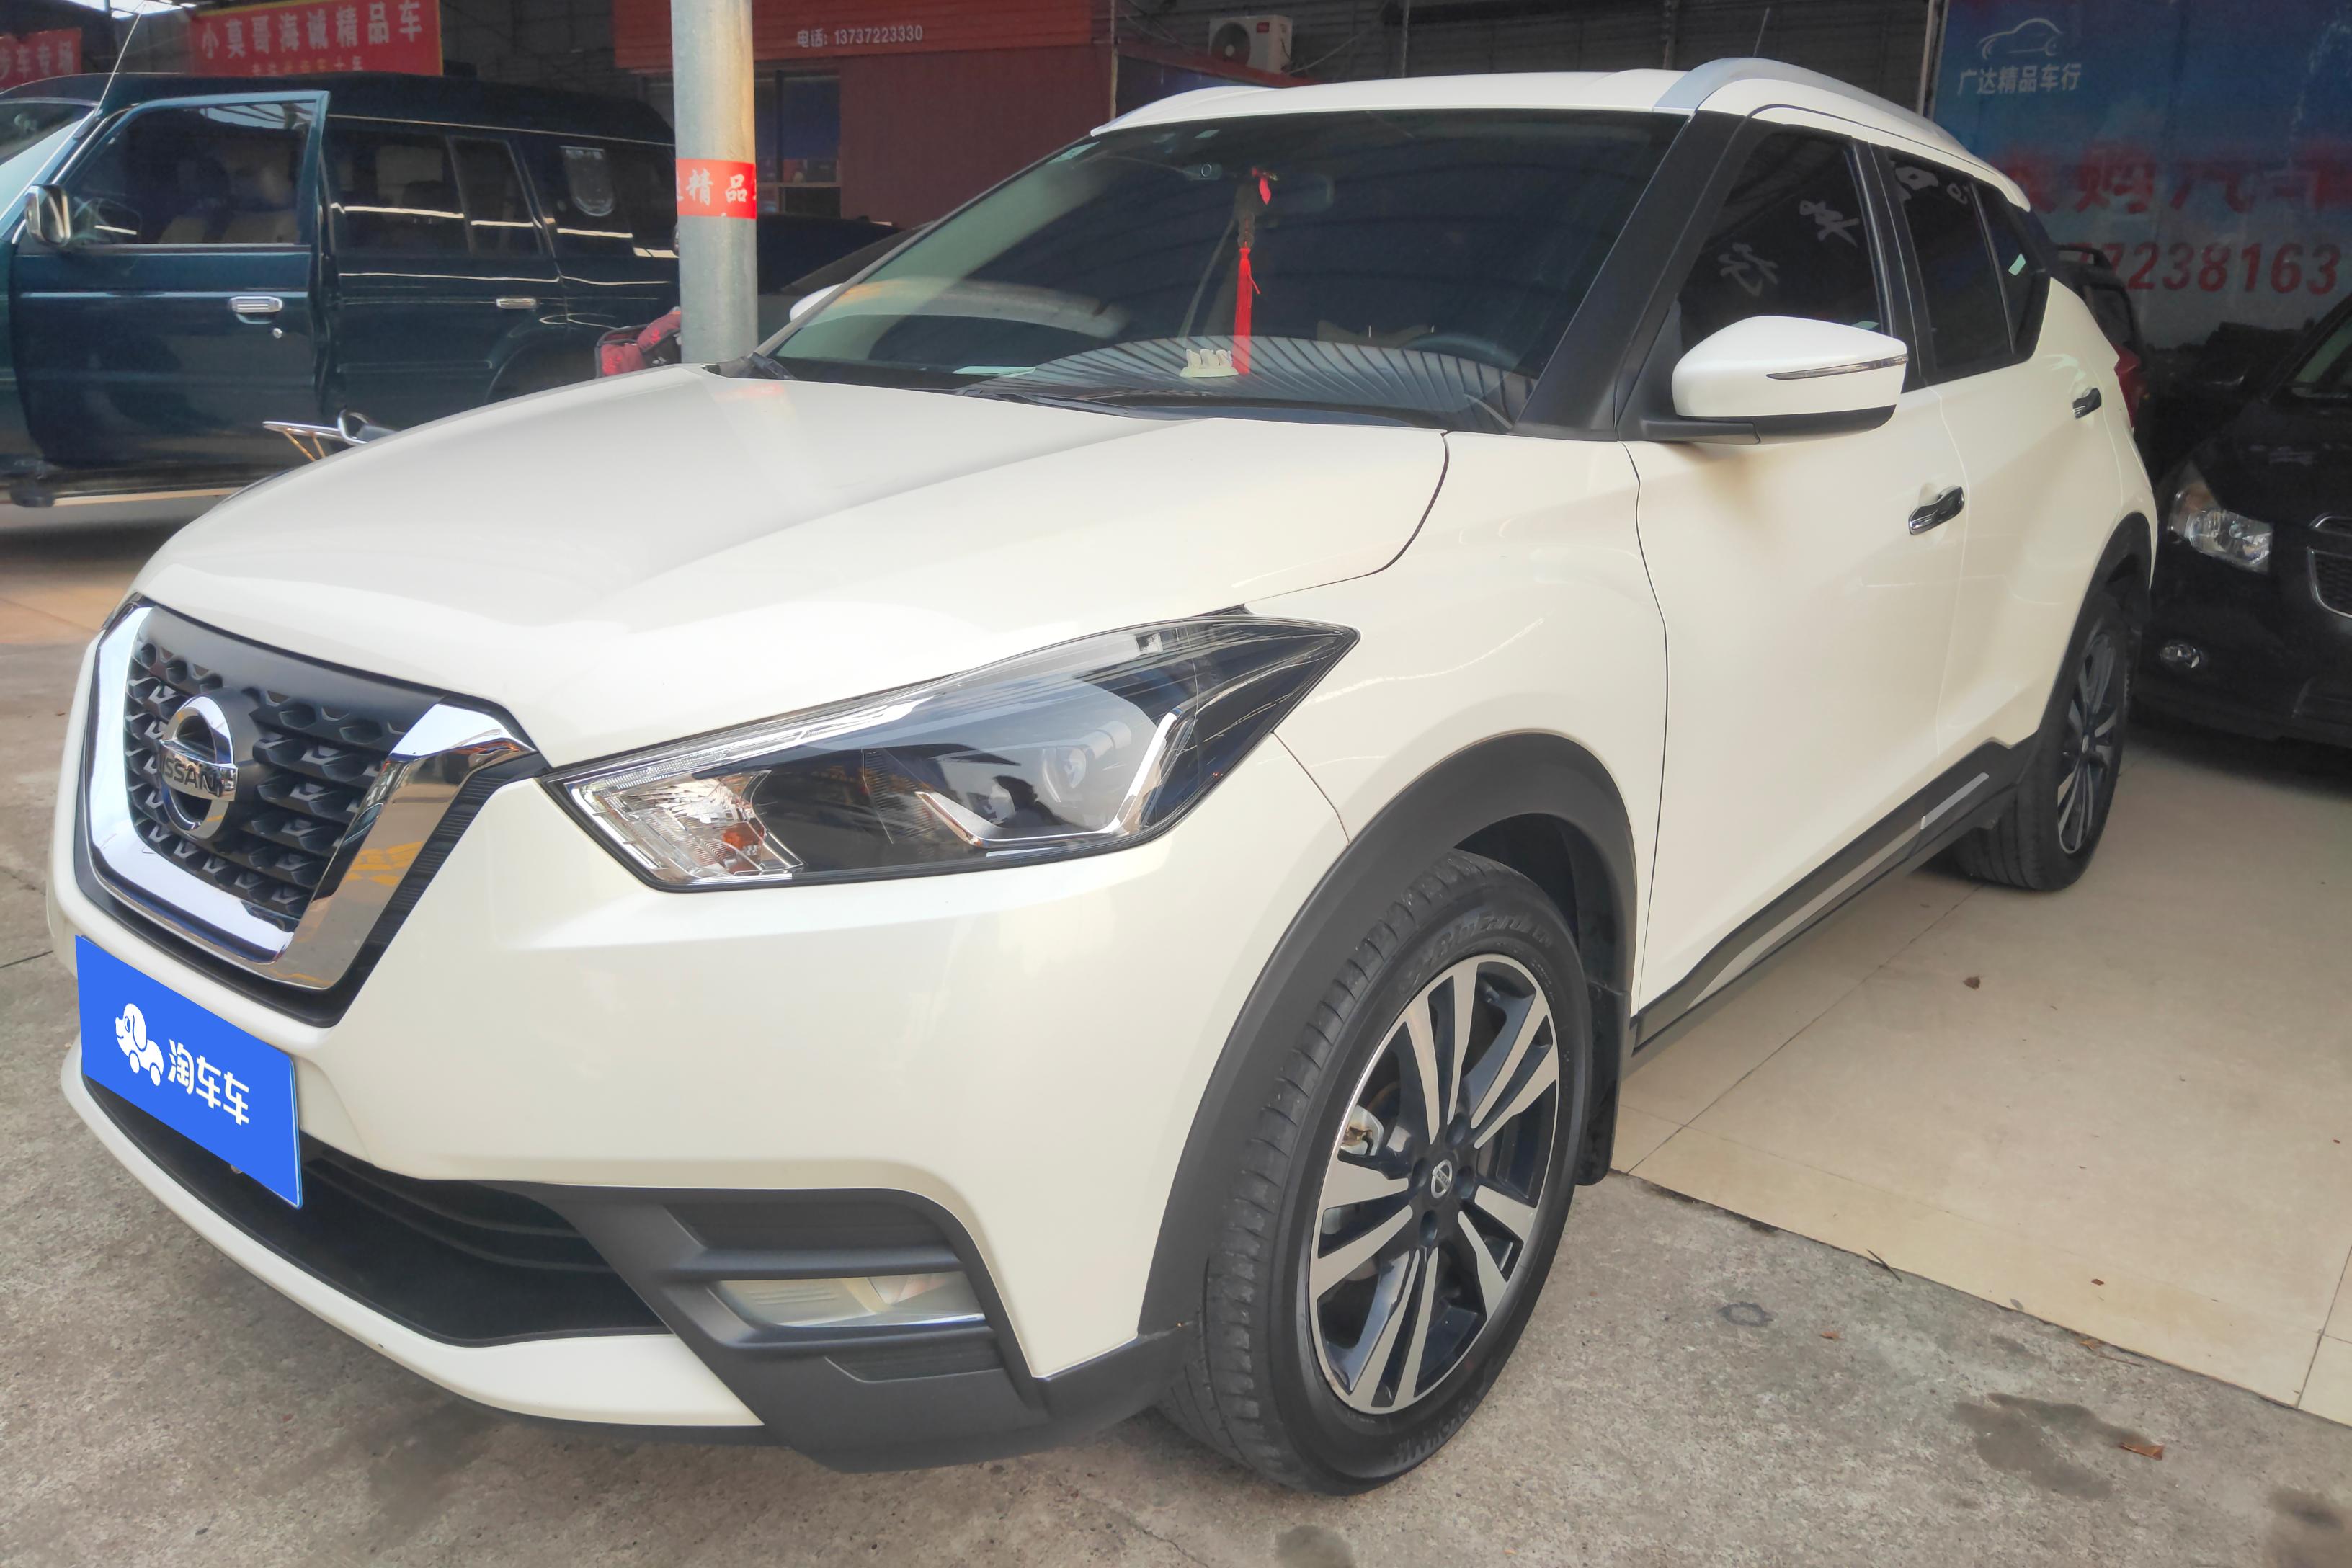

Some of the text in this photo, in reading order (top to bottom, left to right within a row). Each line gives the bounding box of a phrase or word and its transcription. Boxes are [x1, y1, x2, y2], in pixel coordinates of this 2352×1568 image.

[834, 24, 923, 45] 13737223330
[1957, 63, 2081, 96] 广达精品车行
[677, 167, 756, 206] 精品
[159, 753, 223, 798] ISSAN
